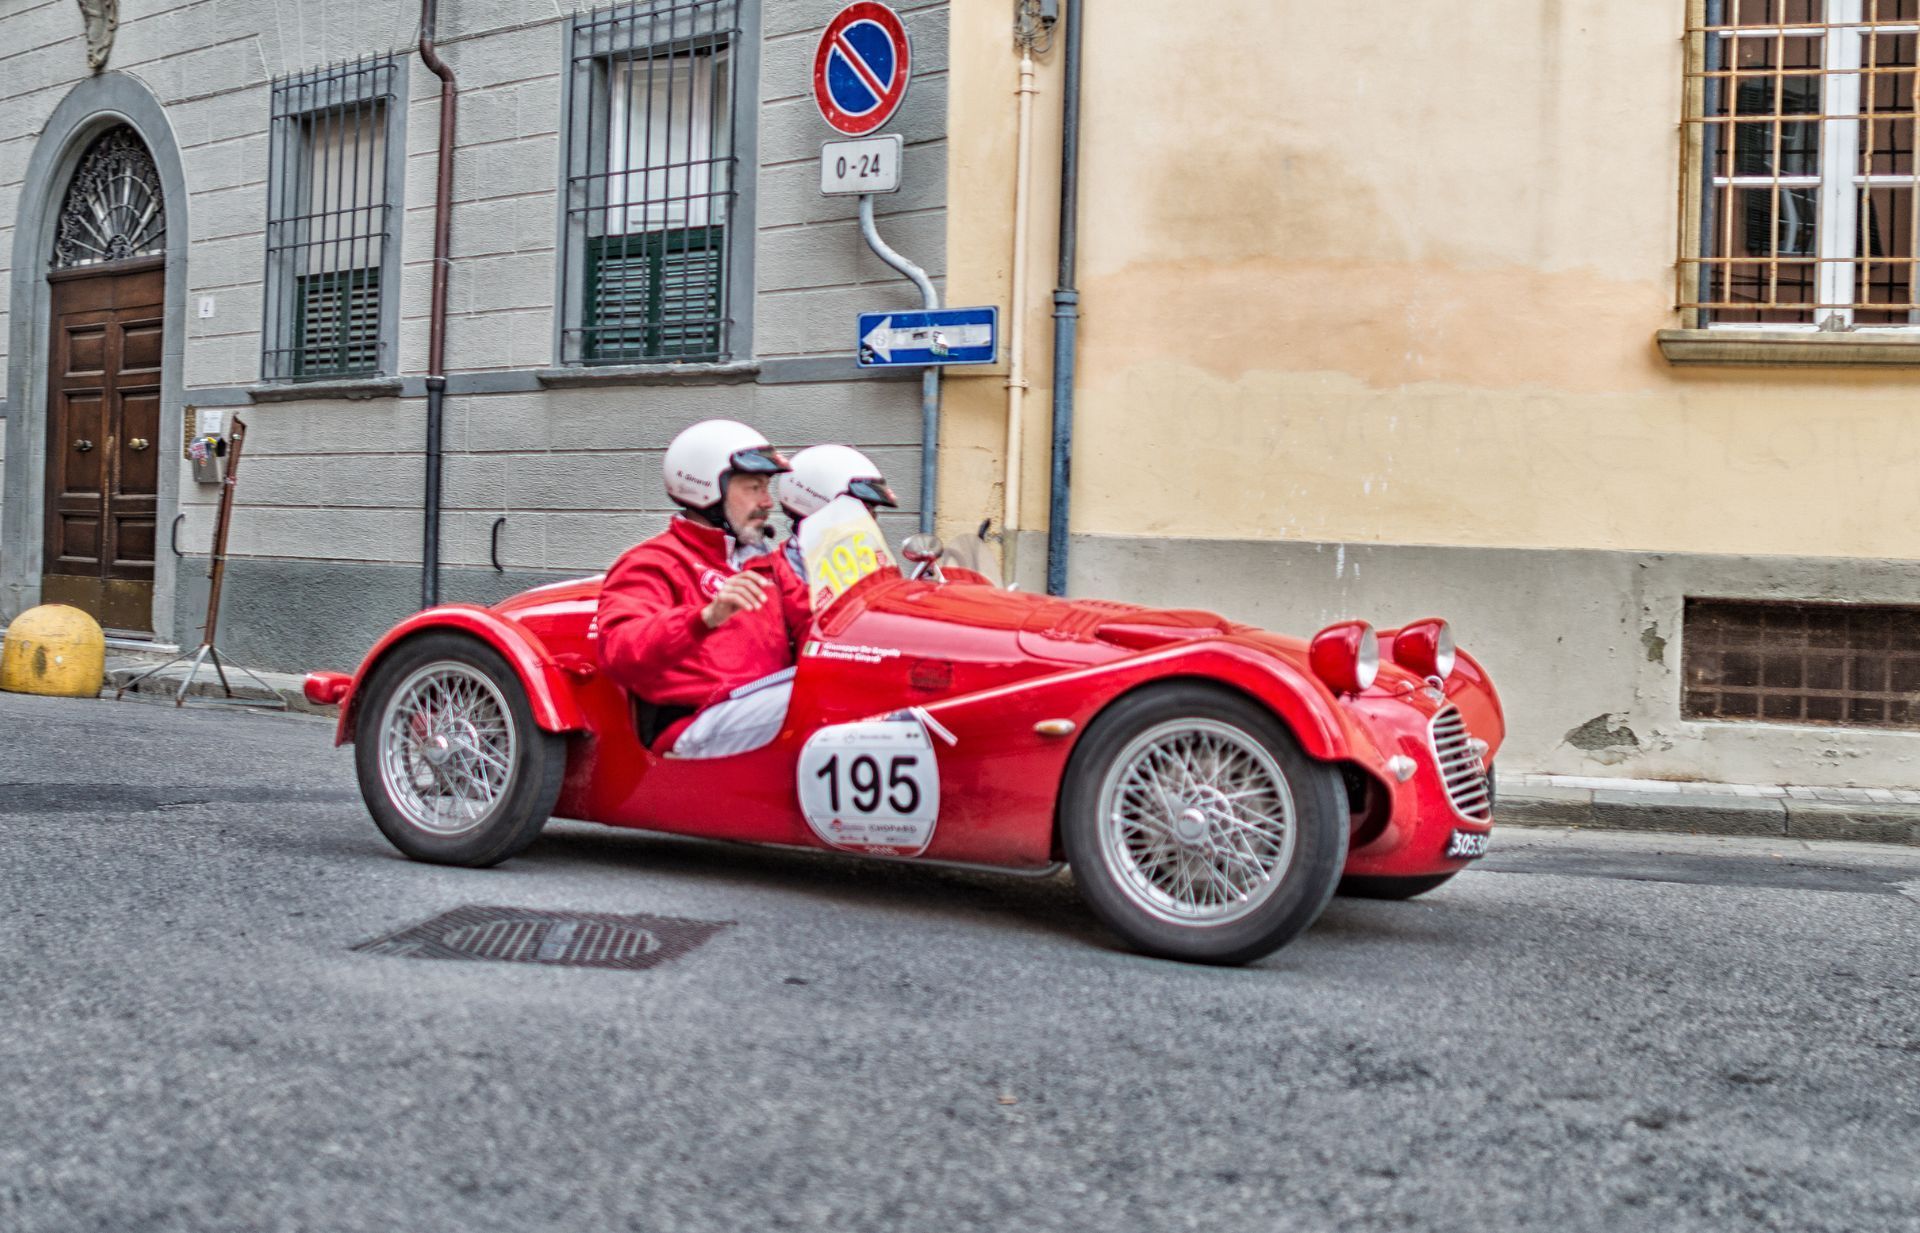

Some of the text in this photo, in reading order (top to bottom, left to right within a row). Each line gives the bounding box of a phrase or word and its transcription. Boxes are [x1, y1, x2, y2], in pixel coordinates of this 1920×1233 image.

[836, 153, 880, 179] 0-24
[818, 532, 878, 594] 195
[816, 753, 920, 814] 195
